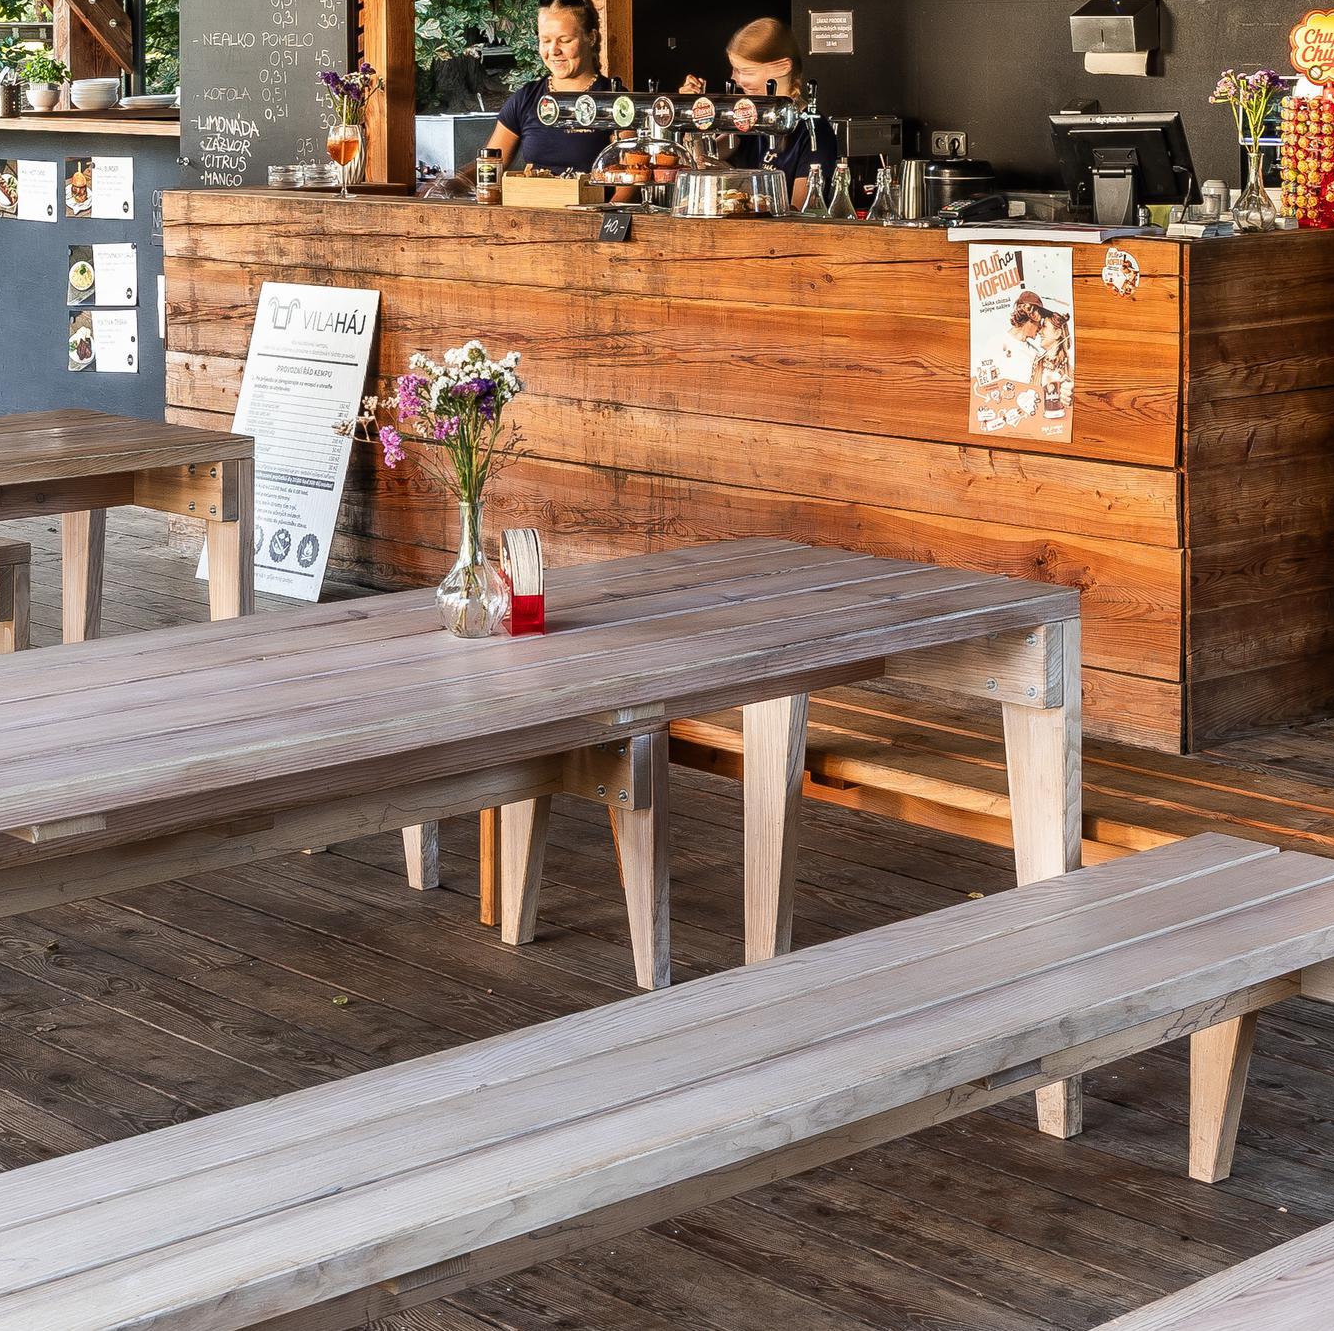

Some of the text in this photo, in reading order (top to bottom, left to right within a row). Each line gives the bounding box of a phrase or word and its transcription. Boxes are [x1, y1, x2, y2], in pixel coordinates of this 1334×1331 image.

[203, 32, 314, 48] NEALKO POMELO
[203, 87, 252, 103] KOFOLA
[204, 154, 247, 172] CITRUS
[204, 170, 243, 187] MANGO
[999, 251, 1014, 270] na
